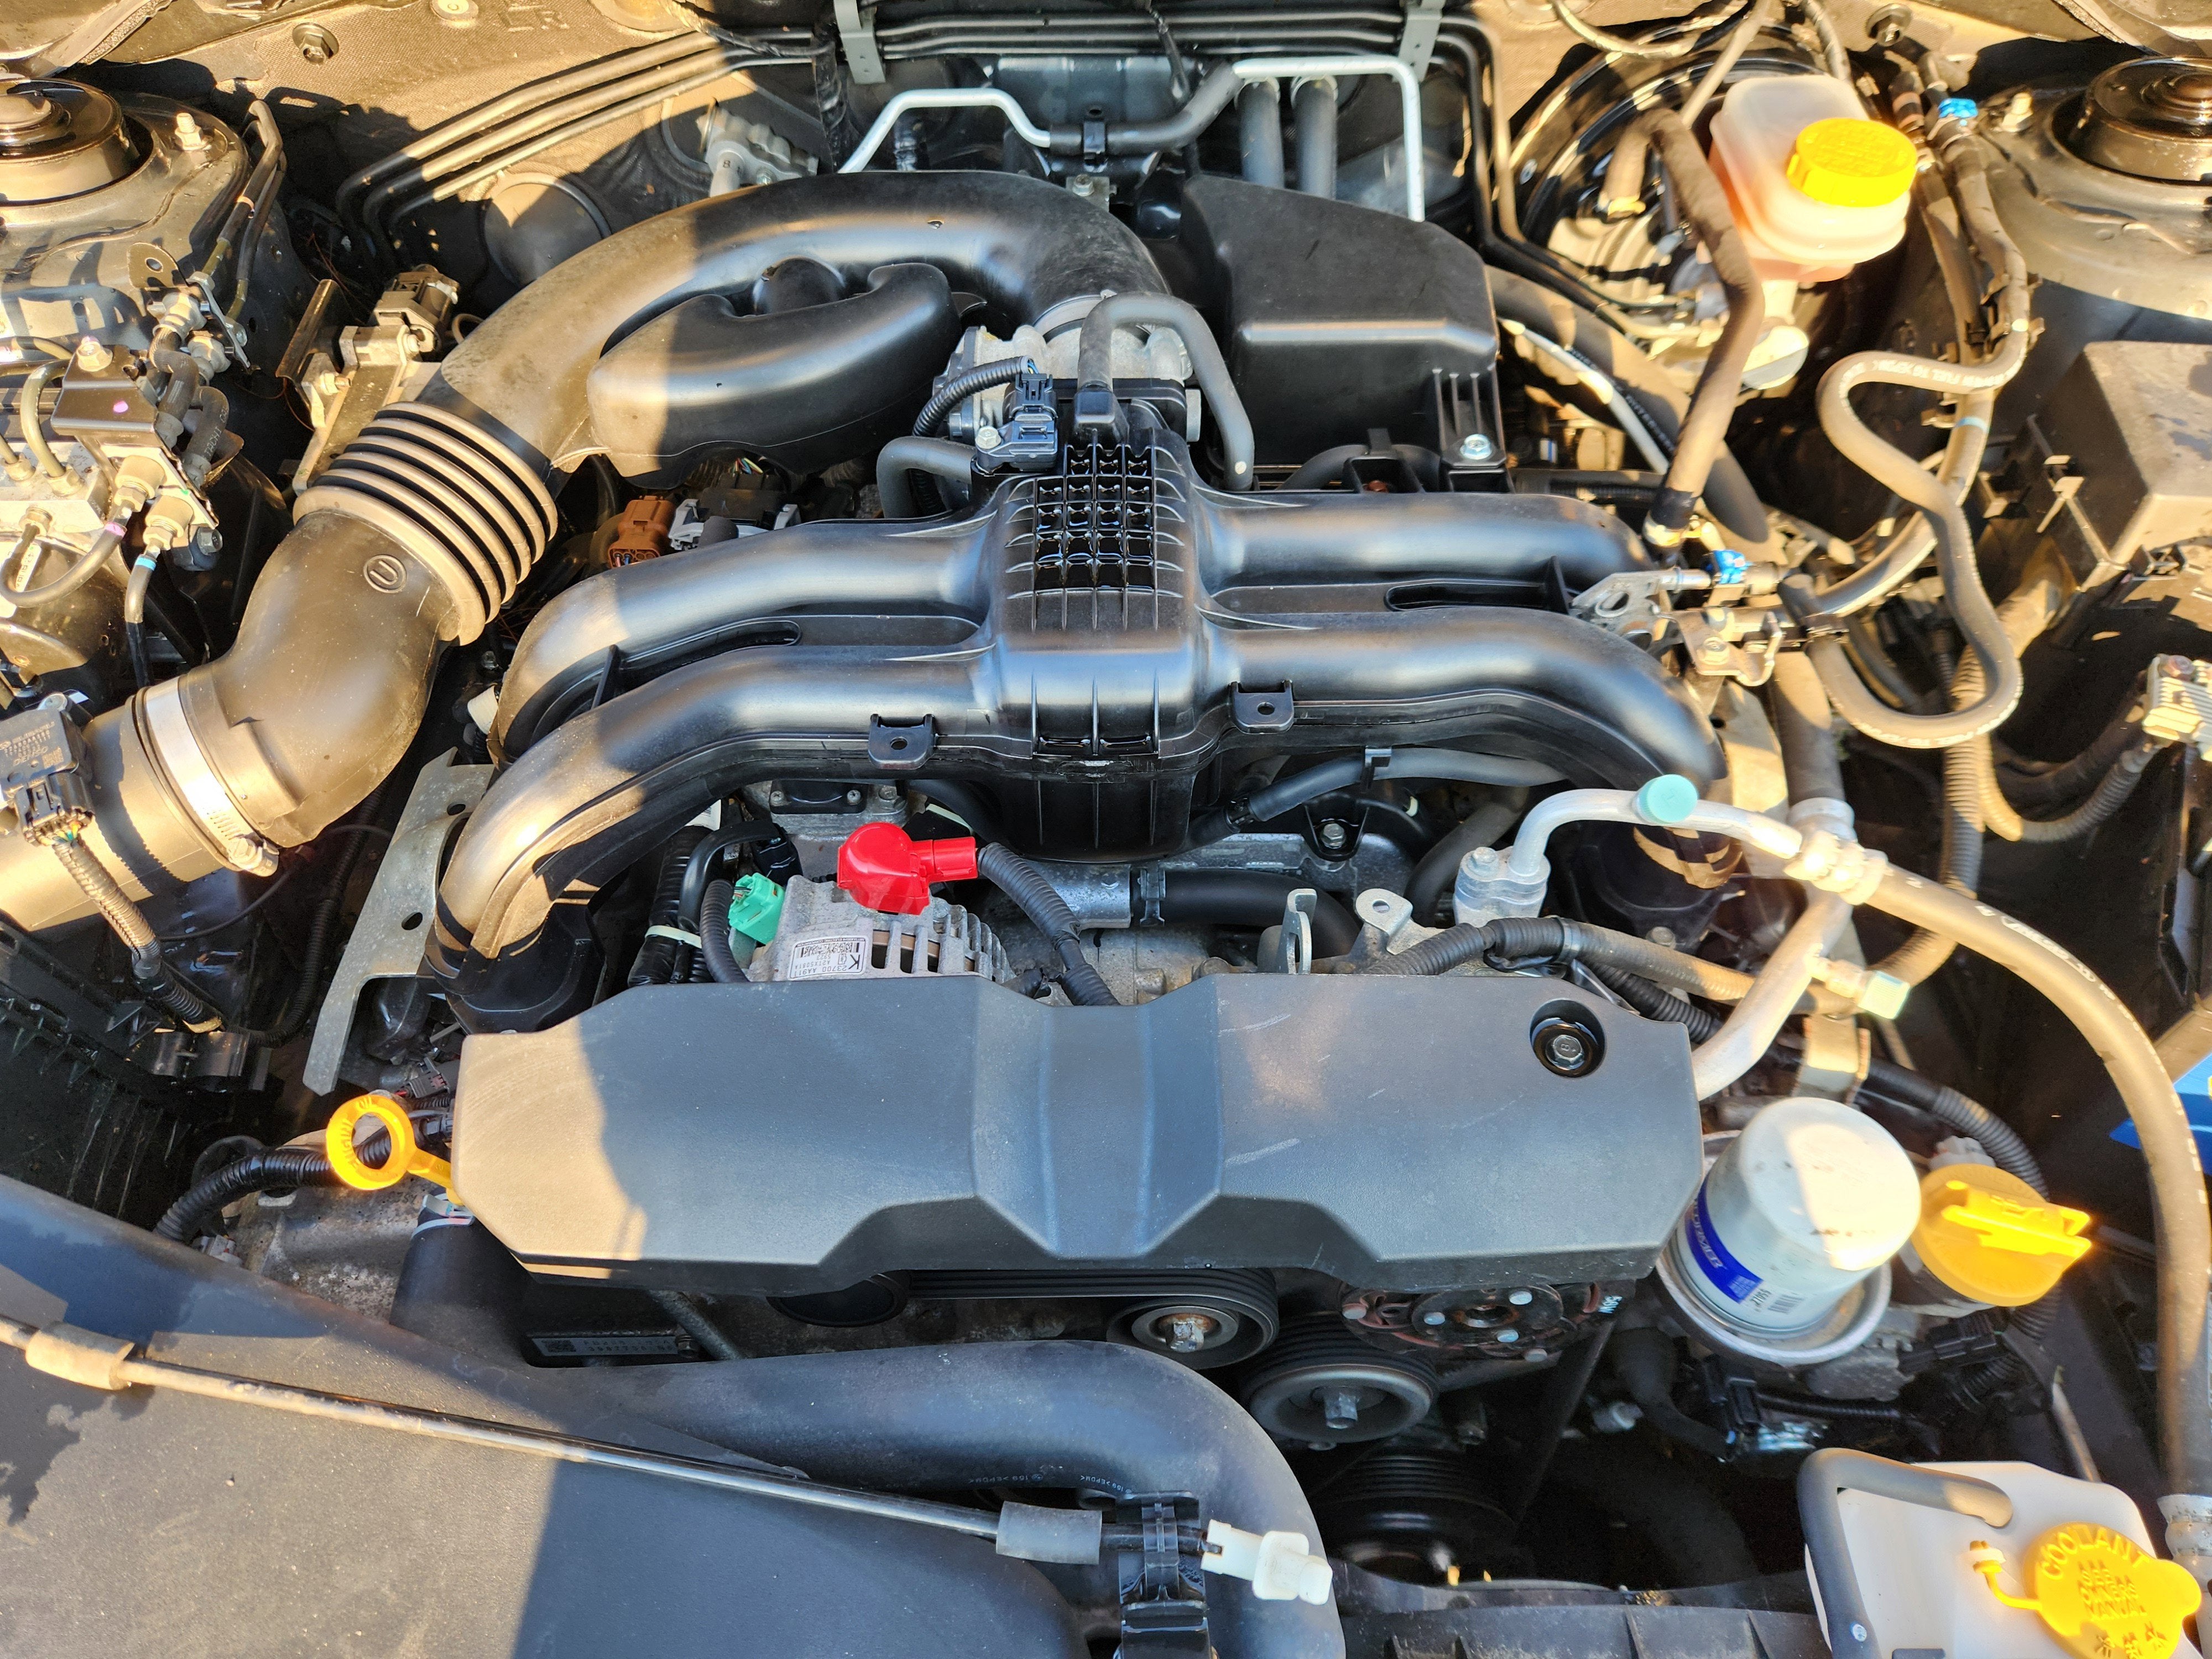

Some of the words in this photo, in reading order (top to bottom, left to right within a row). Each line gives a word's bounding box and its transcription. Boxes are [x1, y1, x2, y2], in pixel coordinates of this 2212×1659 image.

[848, 954, 860, 970] K
[2041, 1525, 2151, 1580] COOLANT
[2080, 1565, 2116, 1587] SEE
[2080, 1582, 2139, 1604] OWNERS
[2085, 1600, 2148, 1621] MANUAL
